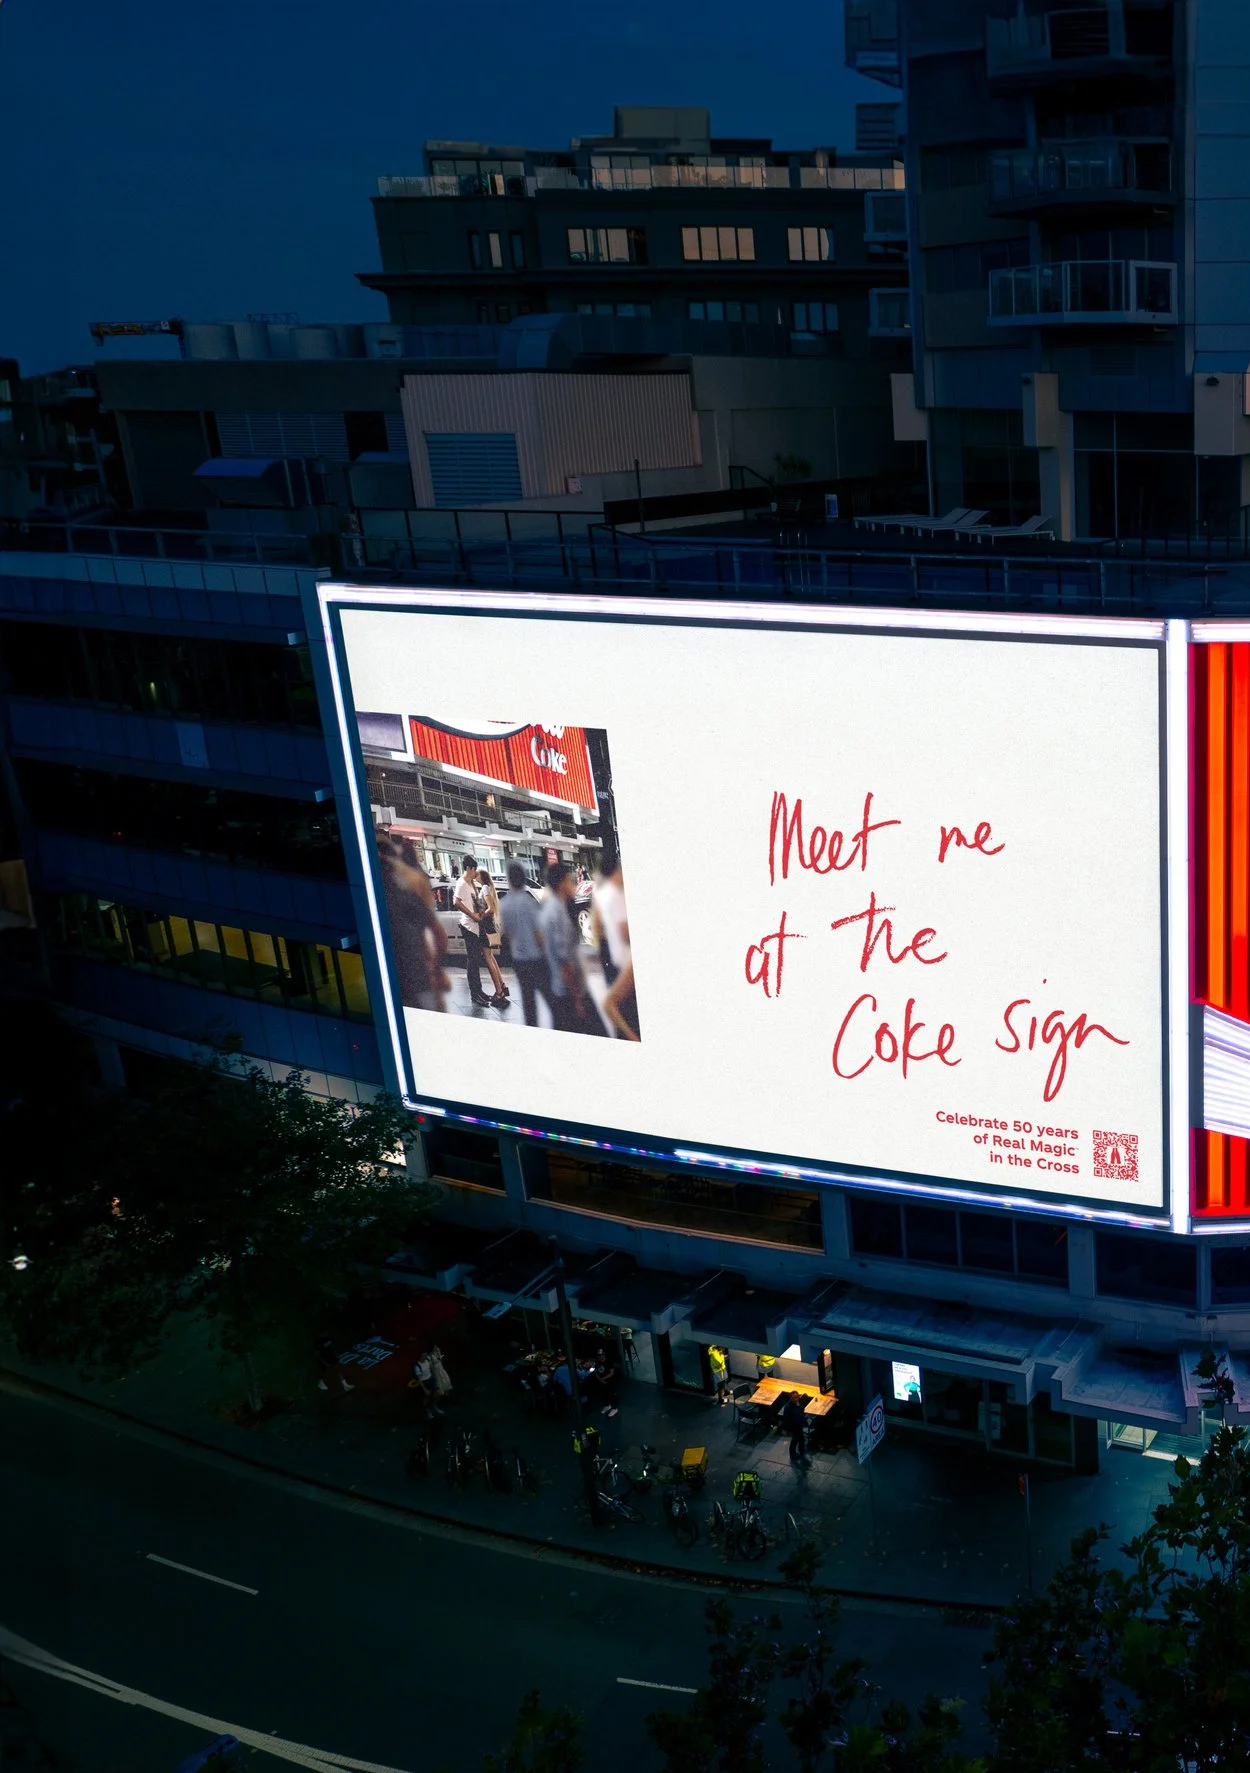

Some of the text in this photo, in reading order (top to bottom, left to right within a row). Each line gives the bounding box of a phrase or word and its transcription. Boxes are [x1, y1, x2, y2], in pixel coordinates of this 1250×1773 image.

[530, 736, 568, 776] Coke
[768, 791, 1006, 887] Meet me
[745, 891, 949, 998] at the
[832, 993, 962, 1079] Coke
[935, 1110, 1079, 1140] Celebrate 50 years
[973, 1132, 989, 1145] of
[992, 1134, 1026, 1150] Real
[989, 1150, 1080, 1174] in the Cross
[872, 1410, 882, 1428] 40
